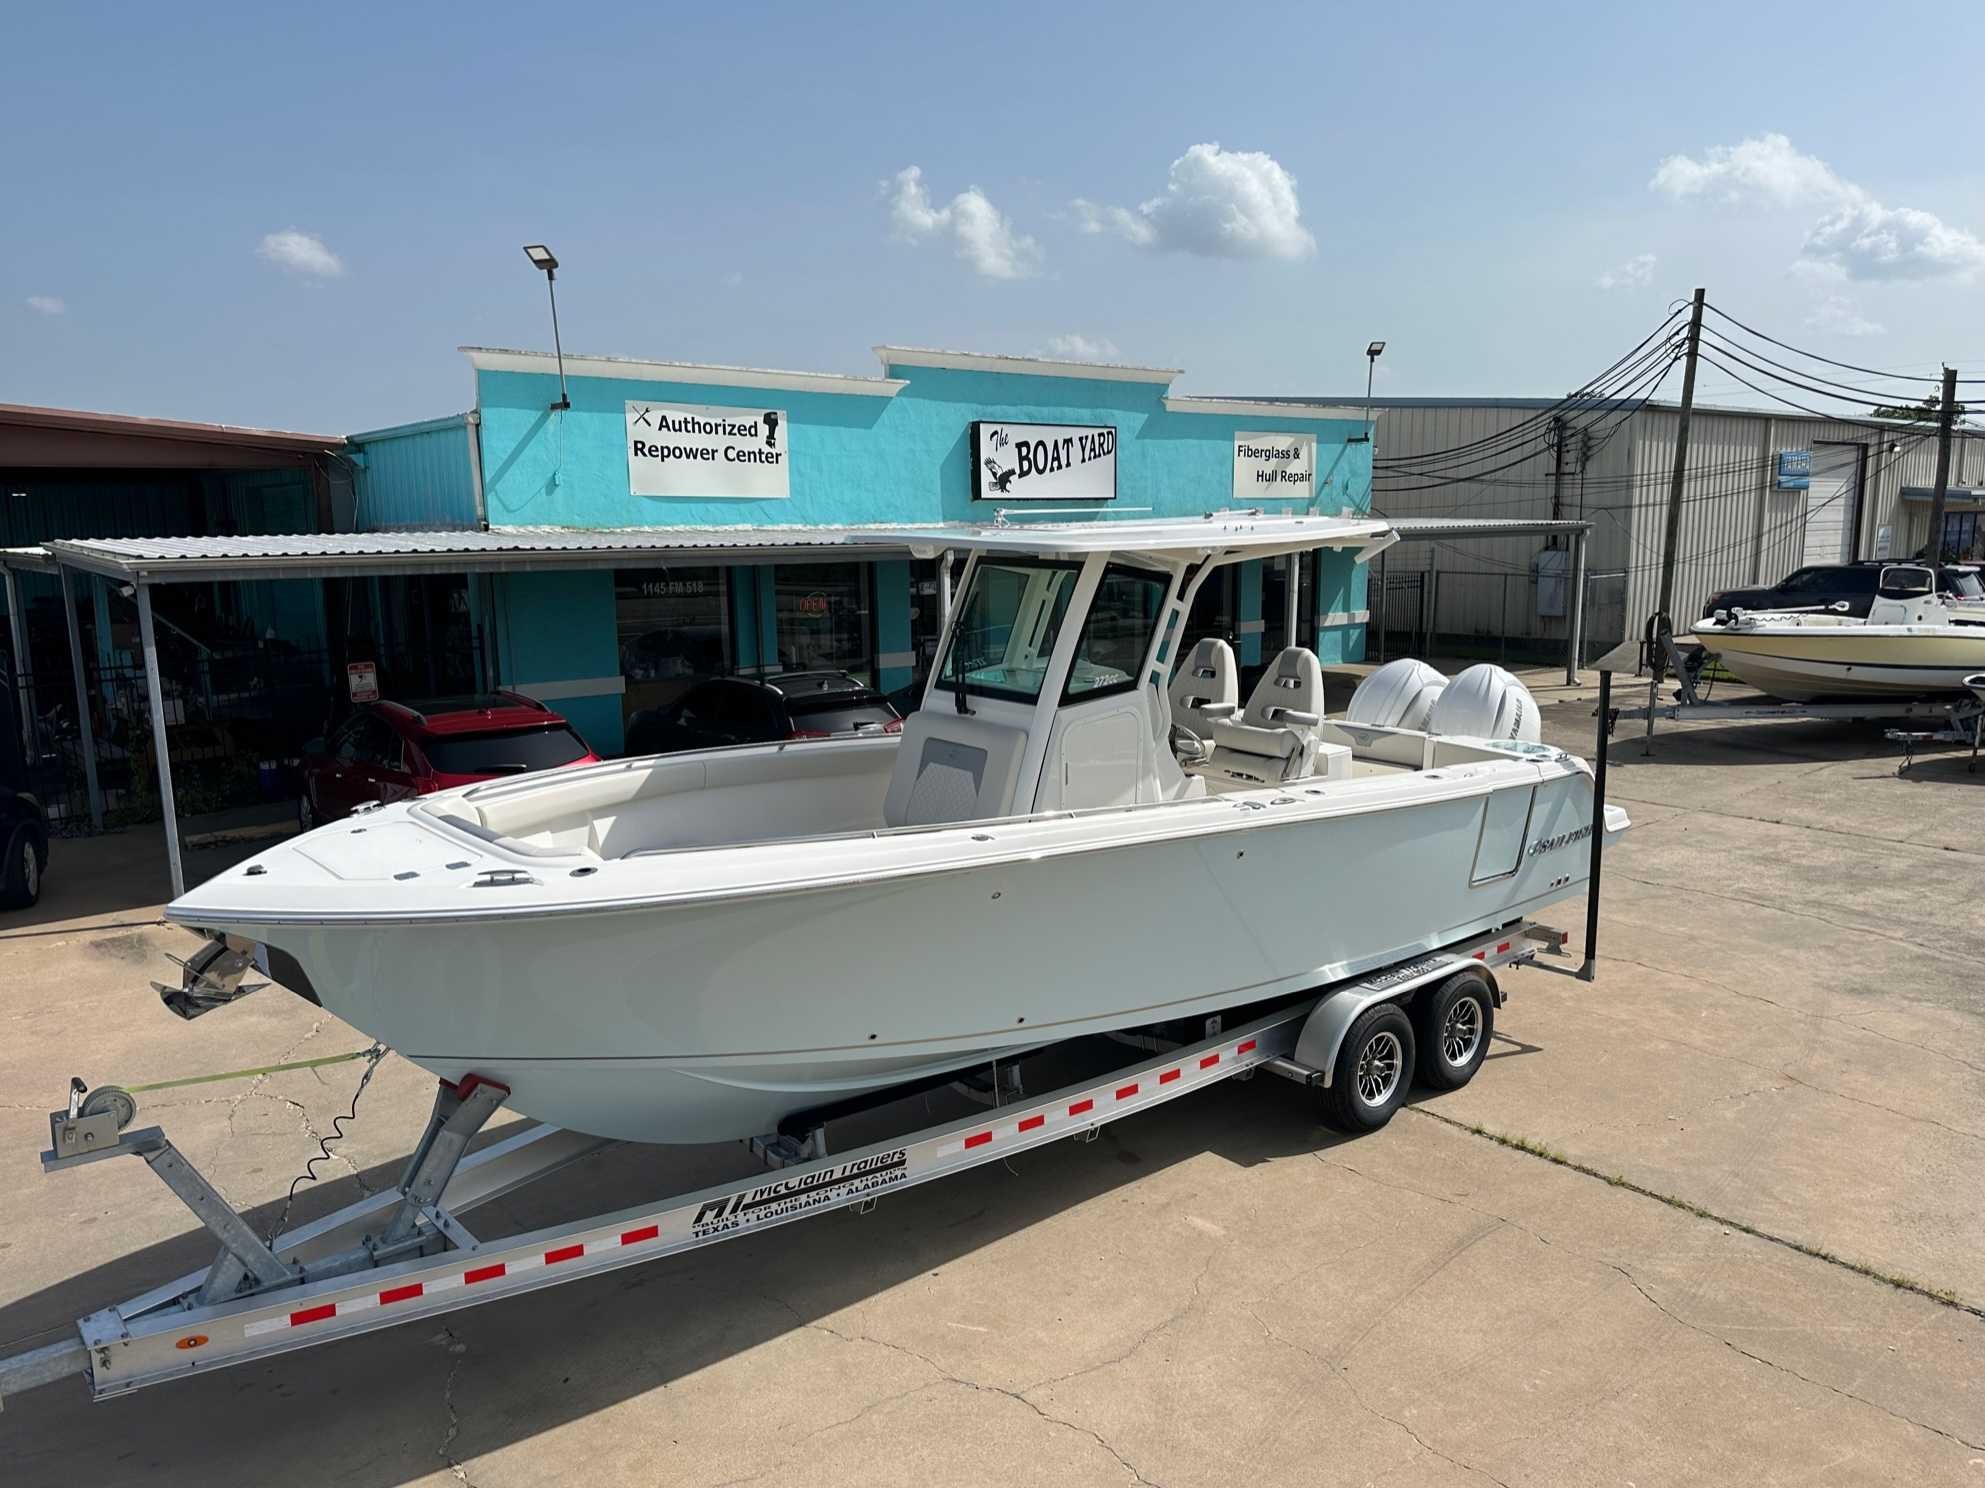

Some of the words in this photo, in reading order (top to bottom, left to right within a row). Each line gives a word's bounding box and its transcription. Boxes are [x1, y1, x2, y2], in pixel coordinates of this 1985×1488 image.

[658, 415, 758, 437] Authorized
[989, 427, 1009, 452] The
[633, 440, 718, 462] Repower
[723, 445, 782, 464] Center
[1015, 437, 1073, 479] BOAT
[1079, 430, 1115, 464] YARD
[1237, 445, 1291, 461] Fiberglass
[1293, 447, 1300, 459] &
[1256, 470, 1277, 482] Hull
[1280, 470, 1312, 485] Repair
[692, 1220, 740, 1238] TEXAS
[756, 1195, 832, 1221] LOUISIANA
[846, 1172, 907, 1196] ALABAMA
